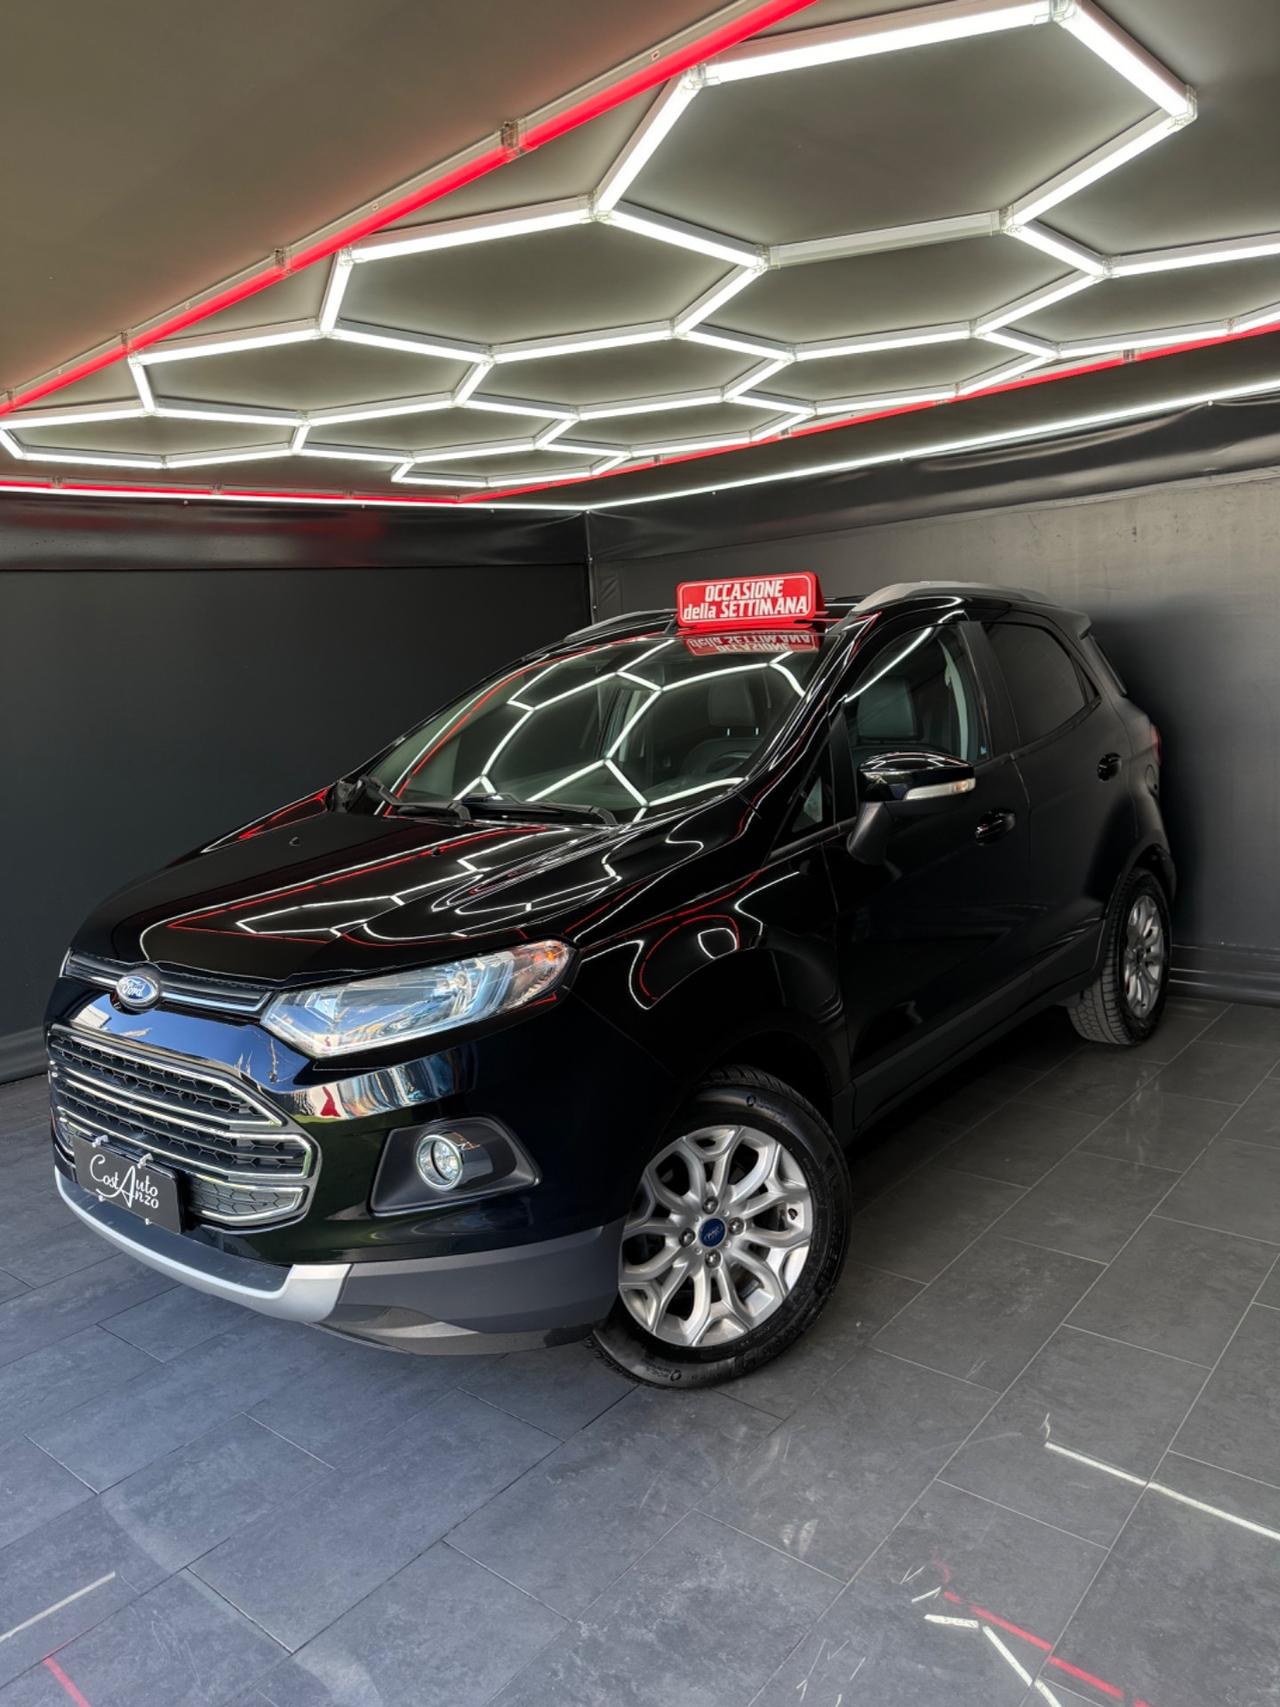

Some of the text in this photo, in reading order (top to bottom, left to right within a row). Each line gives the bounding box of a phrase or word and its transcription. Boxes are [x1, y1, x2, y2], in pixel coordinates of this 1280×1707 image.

[705, 579, 784, 603] OCCASIONE
[683, 596, 807, 620] della SETTIMANA
[121, 979, 146, 998] Ford
